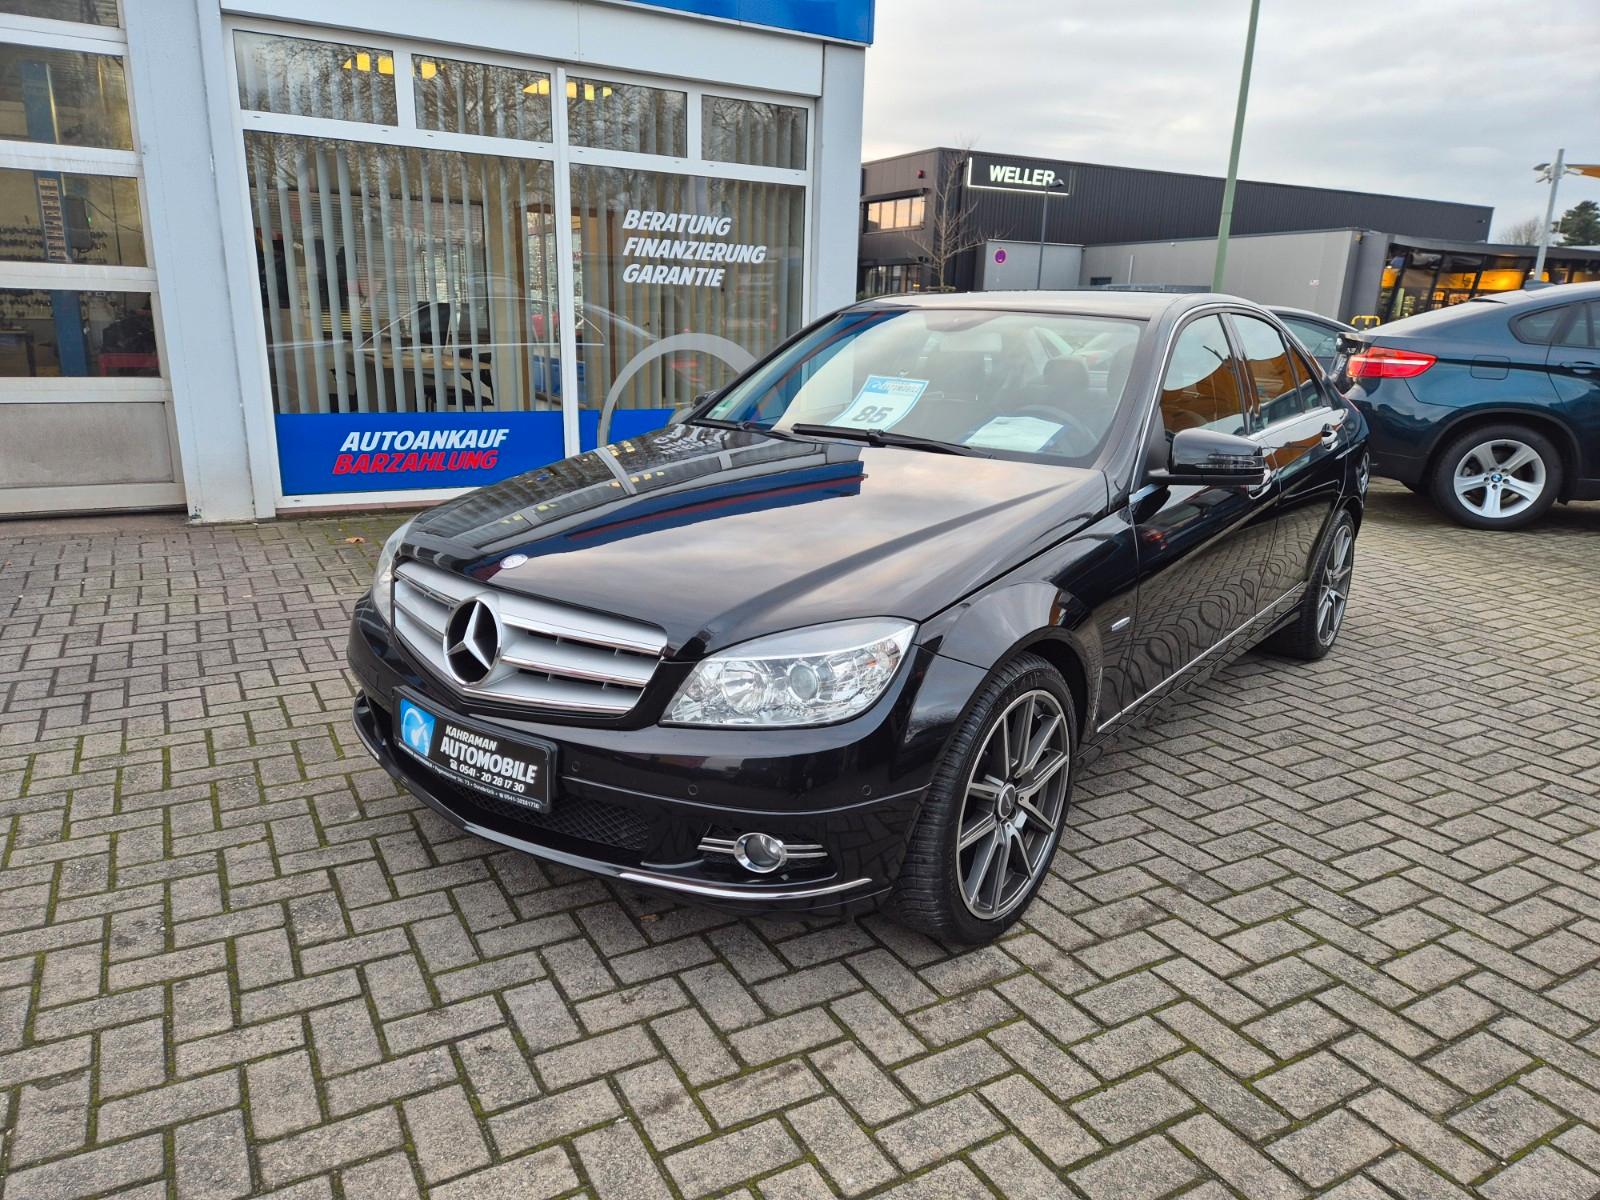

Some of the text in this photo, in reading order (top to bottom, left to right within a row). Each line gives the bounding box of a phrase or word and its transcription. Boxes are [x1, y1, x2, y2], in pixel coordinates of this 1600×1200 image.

[990, 165, 1055, 186] WELLER
[622, 209, 732, 236] BERATUNG
[623, 237, 767, 264] FINANZIERUNG
[622, 263, 726, 287] GARANTIE
[852, 405, 894, 424] 85
[339, 428, 509, 452] AUTOANKAUF
[332, 450, 499, 475] BARZAHLUNG
[445, 724, 498, 751] KAHRAMAN
[440, 736, 537, 784] AUTOMOBILE
[459, 764, 476, 778] 0541
[480, 772, 491, 783] 20
[492, 775, 503, 787] 28
[503, 779, 512, 790] 17
[513, 781, 525, 793] 30
